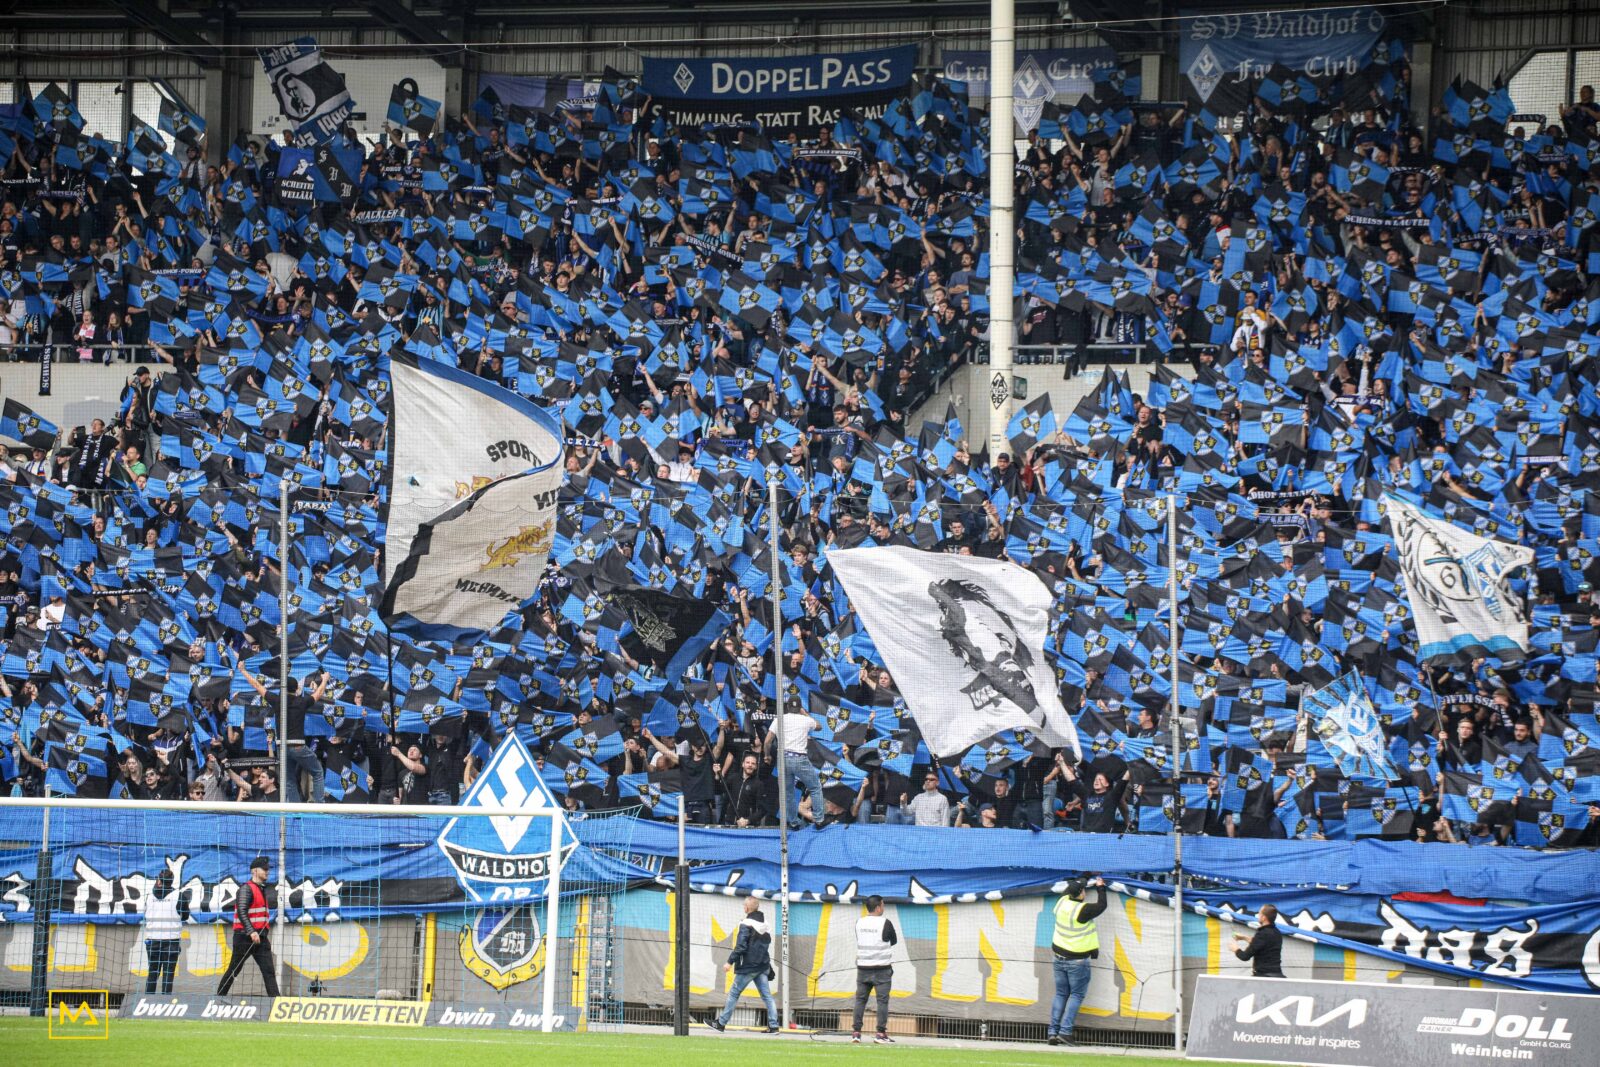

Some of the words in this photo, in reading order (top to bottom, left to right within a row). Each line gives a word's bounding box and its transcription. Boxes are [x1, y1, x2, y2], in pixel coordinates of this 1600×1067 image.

[945, 60, 988, 82] Cra
[755, 111, 802, 128] STATT
[132, 998, 189, 1018] bwin
[200, 1000, 257, 1020] bwin
[274, 1001, 423, 1025] SPORTWETTEN
[438, 1006, 496, 1026] bwin
[508, 1009, 565, 1029] bwn
[1457, 1007, 1574, 1041] DOLL
[1232, 1031, 1292, 1046] Movement
[1294, 1034, 1317, 1047] that
[1318, 1036, 1362, 1050] inspires
[1450, 1042, 1534, 1060] Weinheim
